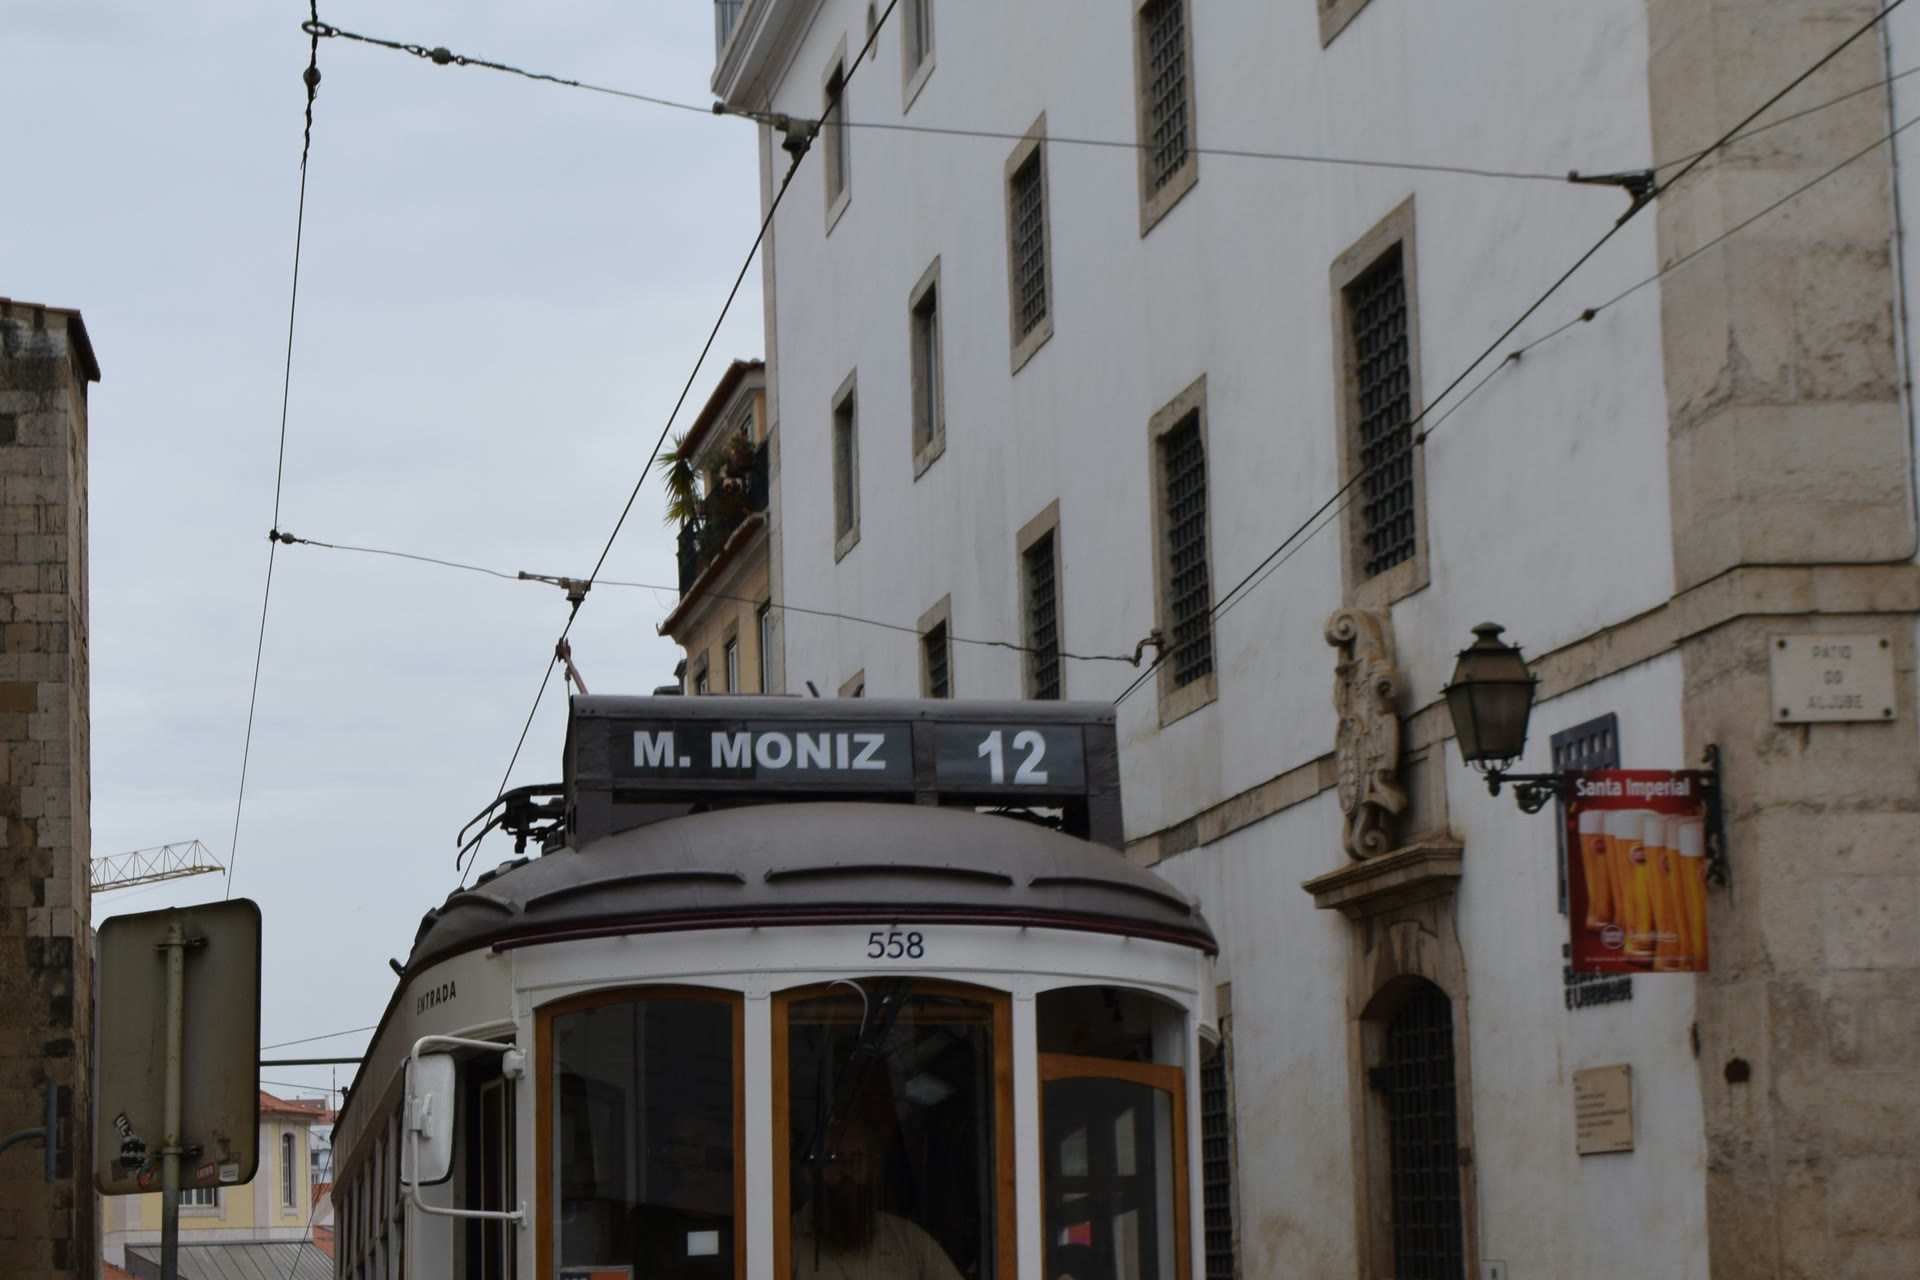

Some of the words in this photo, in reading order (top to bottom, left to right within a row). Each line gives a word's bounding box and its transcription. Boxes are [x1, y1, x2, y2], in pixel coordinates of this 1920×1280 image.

[1823, 670, 1843, 684] DO
[1808, 694, 1863, 710] ALJUBE
[633, 730, 691, 768] M.
[711, 731, 887, 770] MONIZ
[977, 729, 1049, 785] 12
[1576, 778, 1622, 797] Santa
[1626, 777, 1690, 801] Imperial
[867, 931, 925, 960] 558
[416, 980, 457, 1016] ENTRADA
